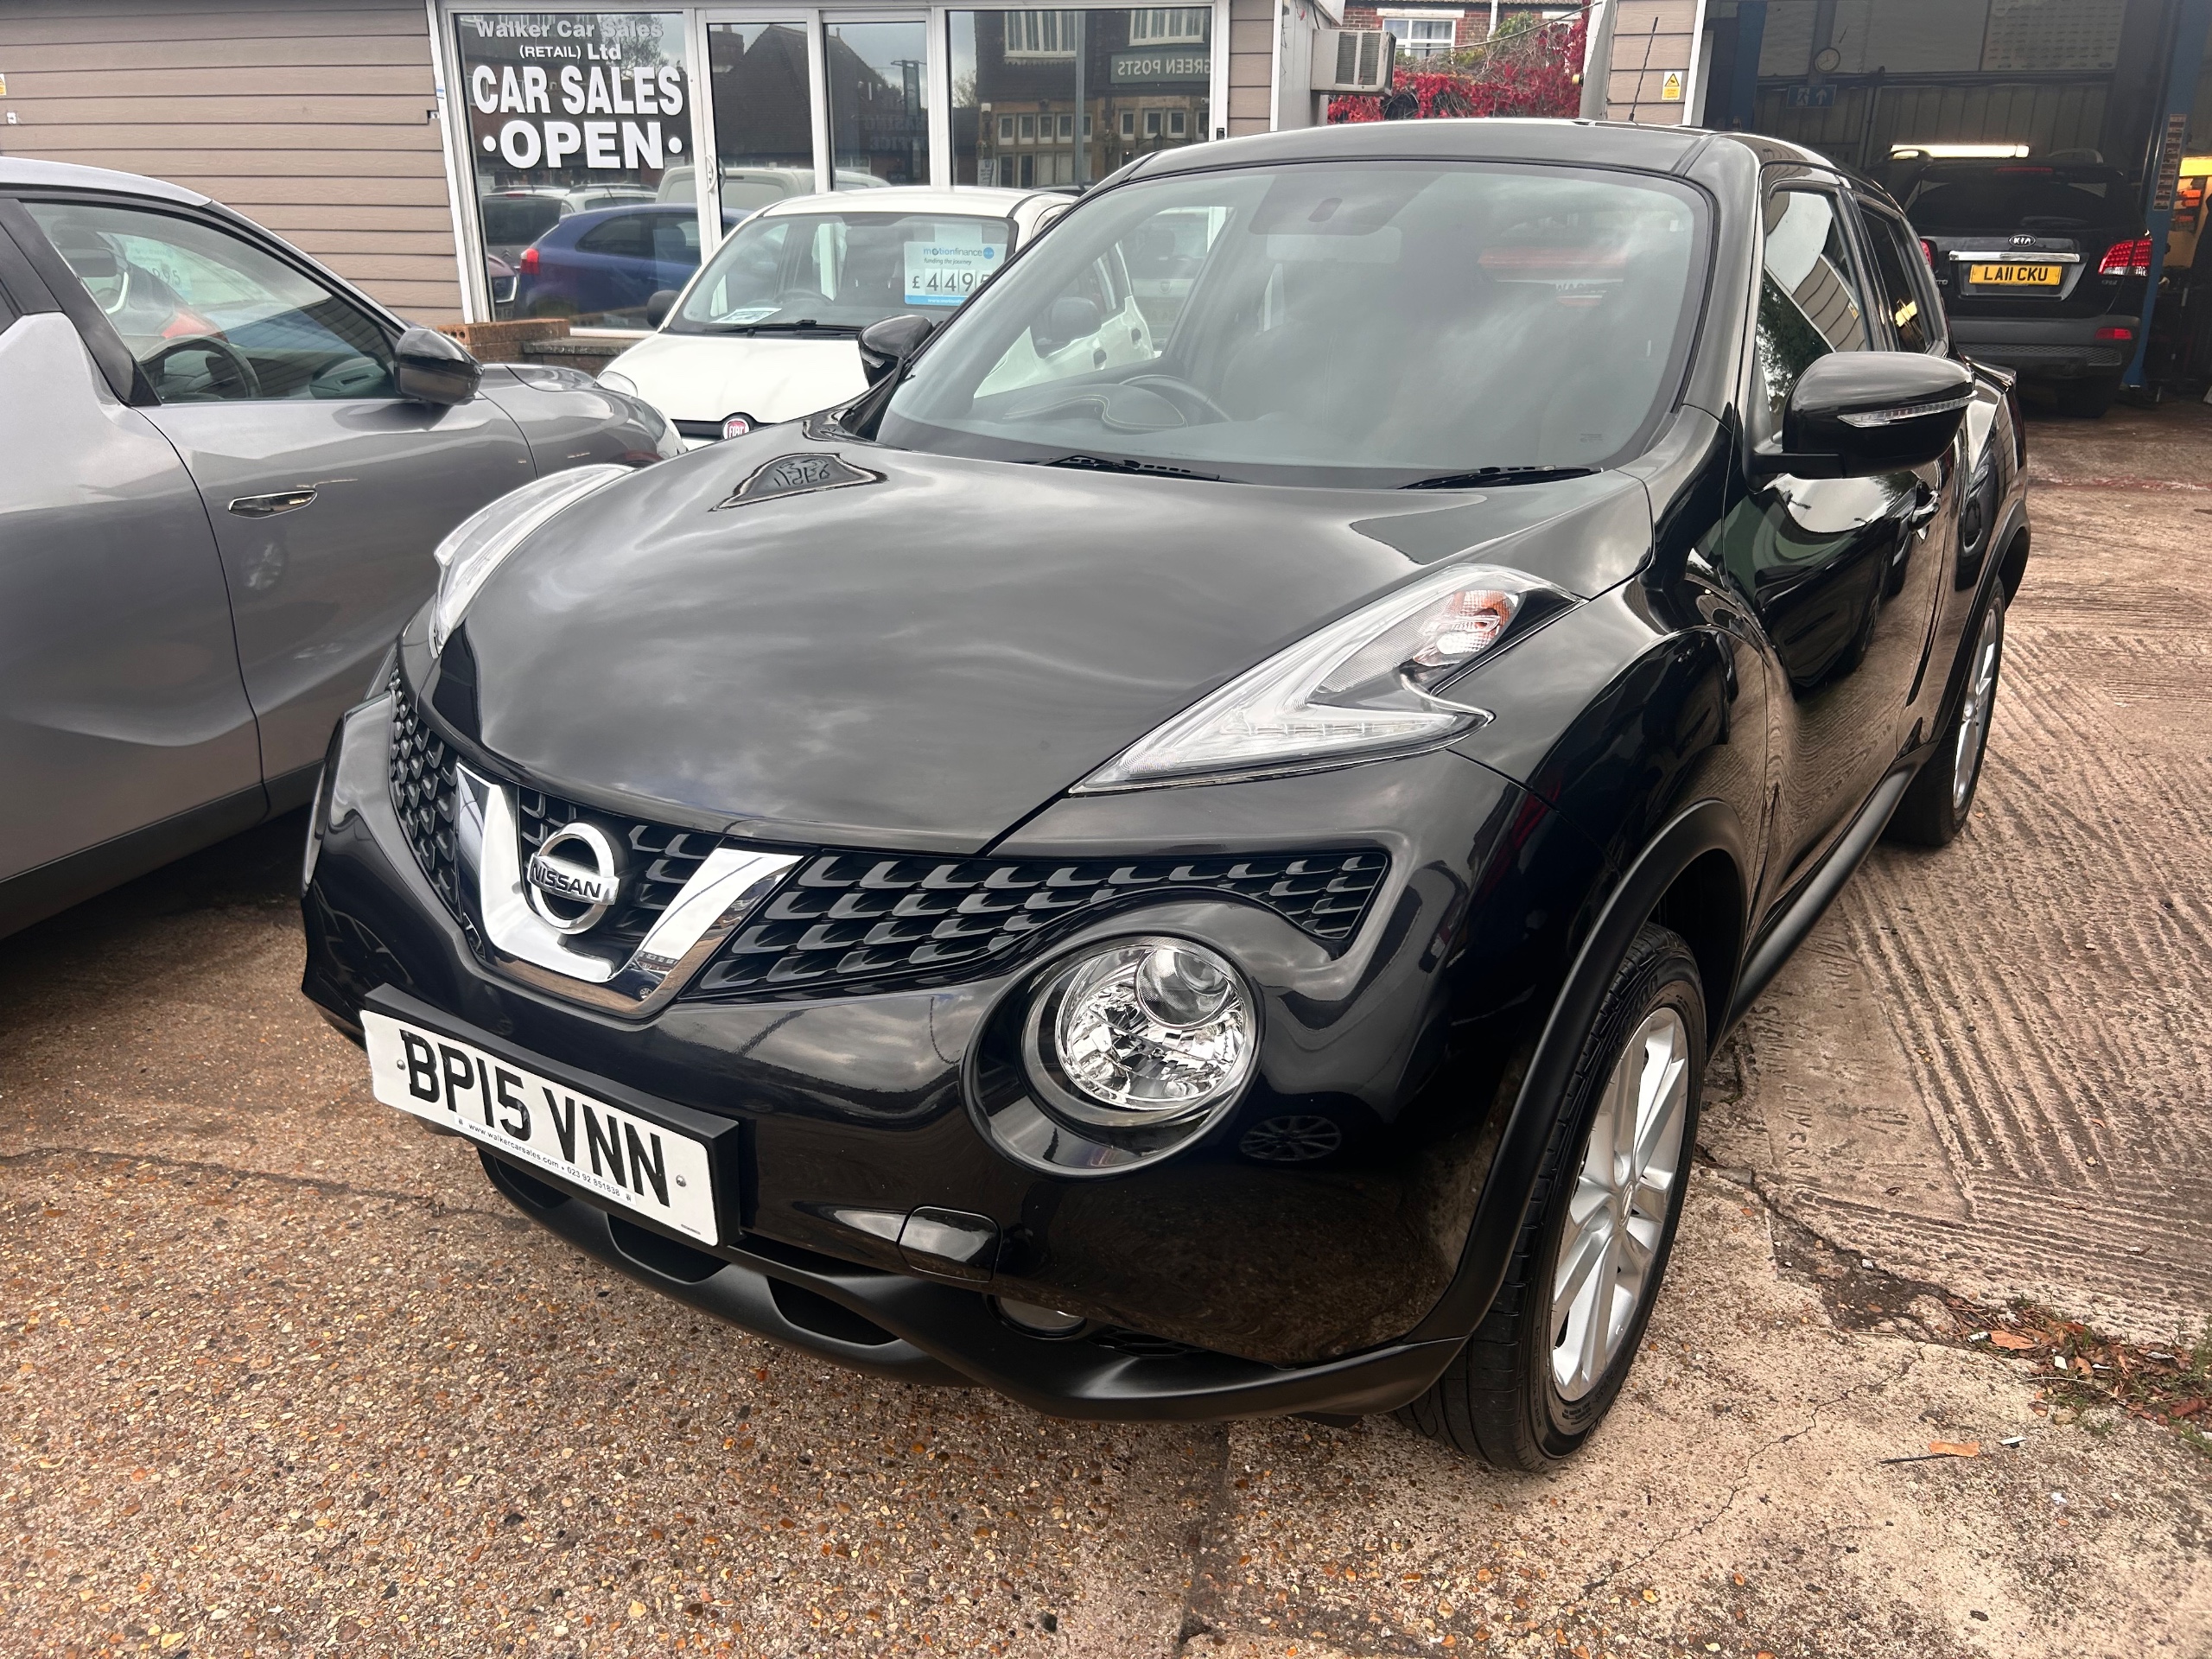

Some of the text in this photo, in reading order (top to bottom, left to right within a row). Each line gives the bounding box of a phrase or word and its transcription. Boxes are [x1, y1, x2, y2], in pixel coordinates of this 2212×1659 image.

[476, 20, 664, 38] Walker Car Sales
[519, 43, 622, 60] (RETAIL) Ltd
[473, 65, 683, 116] CAR SALES
[499, 119, 664, 169] OPEN
[2012, 237, 2032, 245] KIA
[923, 247, 982, 257] motionfinance
[1983, 266, 2049, 282] LA11 CKU
[728, 425, 745, 439] FIAT
[531, 863, 601, 899] NISSAN
[399, 1029, 671, 1208] BP15 VNN
[468, 1123, 560, 1169] www.walkercarsales.com
[567, 1166, 581, 1179] 023
[582, 1173, 591, 1184] 92
